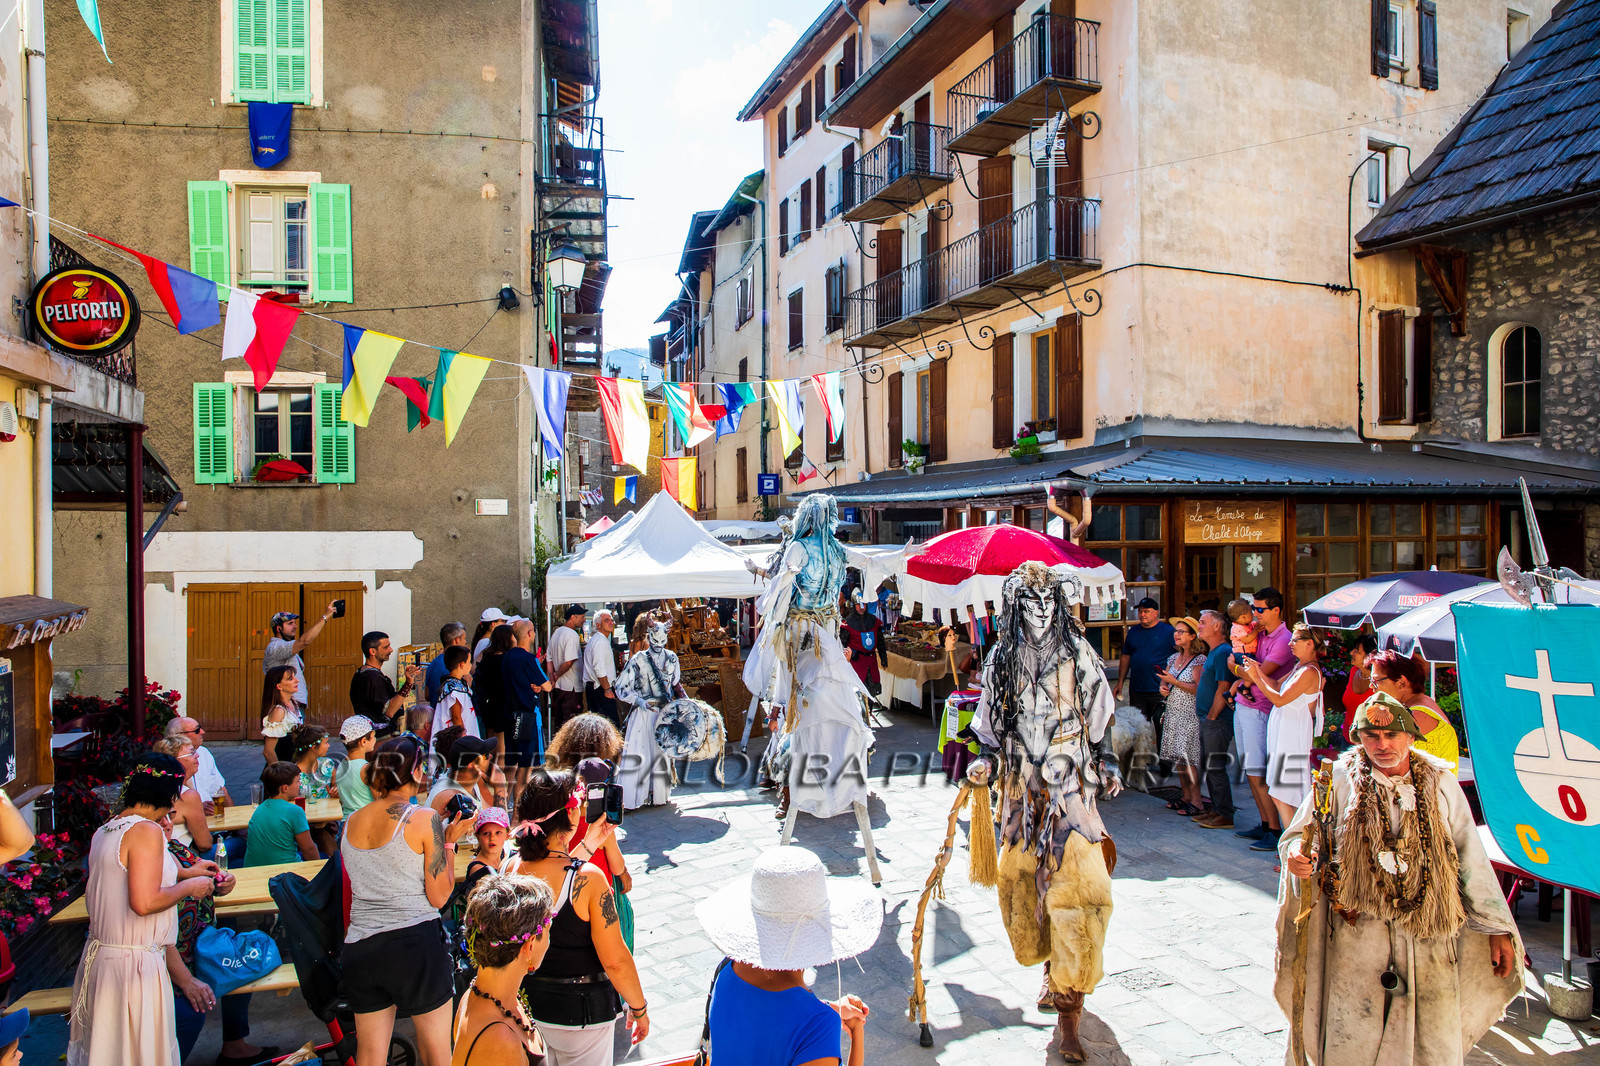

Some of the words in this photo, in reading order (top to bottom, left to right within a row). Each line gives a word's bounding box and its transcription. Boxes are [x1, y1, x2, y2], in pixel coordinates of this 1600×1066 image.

[44, 301, 122, 322] PELFORTH
[1189, 502, 1204, 522] La
[1254, 507, 1265, 520] du
[1202, 524, 1231, 541] Chalet
[1233, 523, 1263, 541] d'Alpage
[523, 587, 529, 597] 6
[6, 623, 31, 650] Le
[1515, 824, 1549, 864] C
